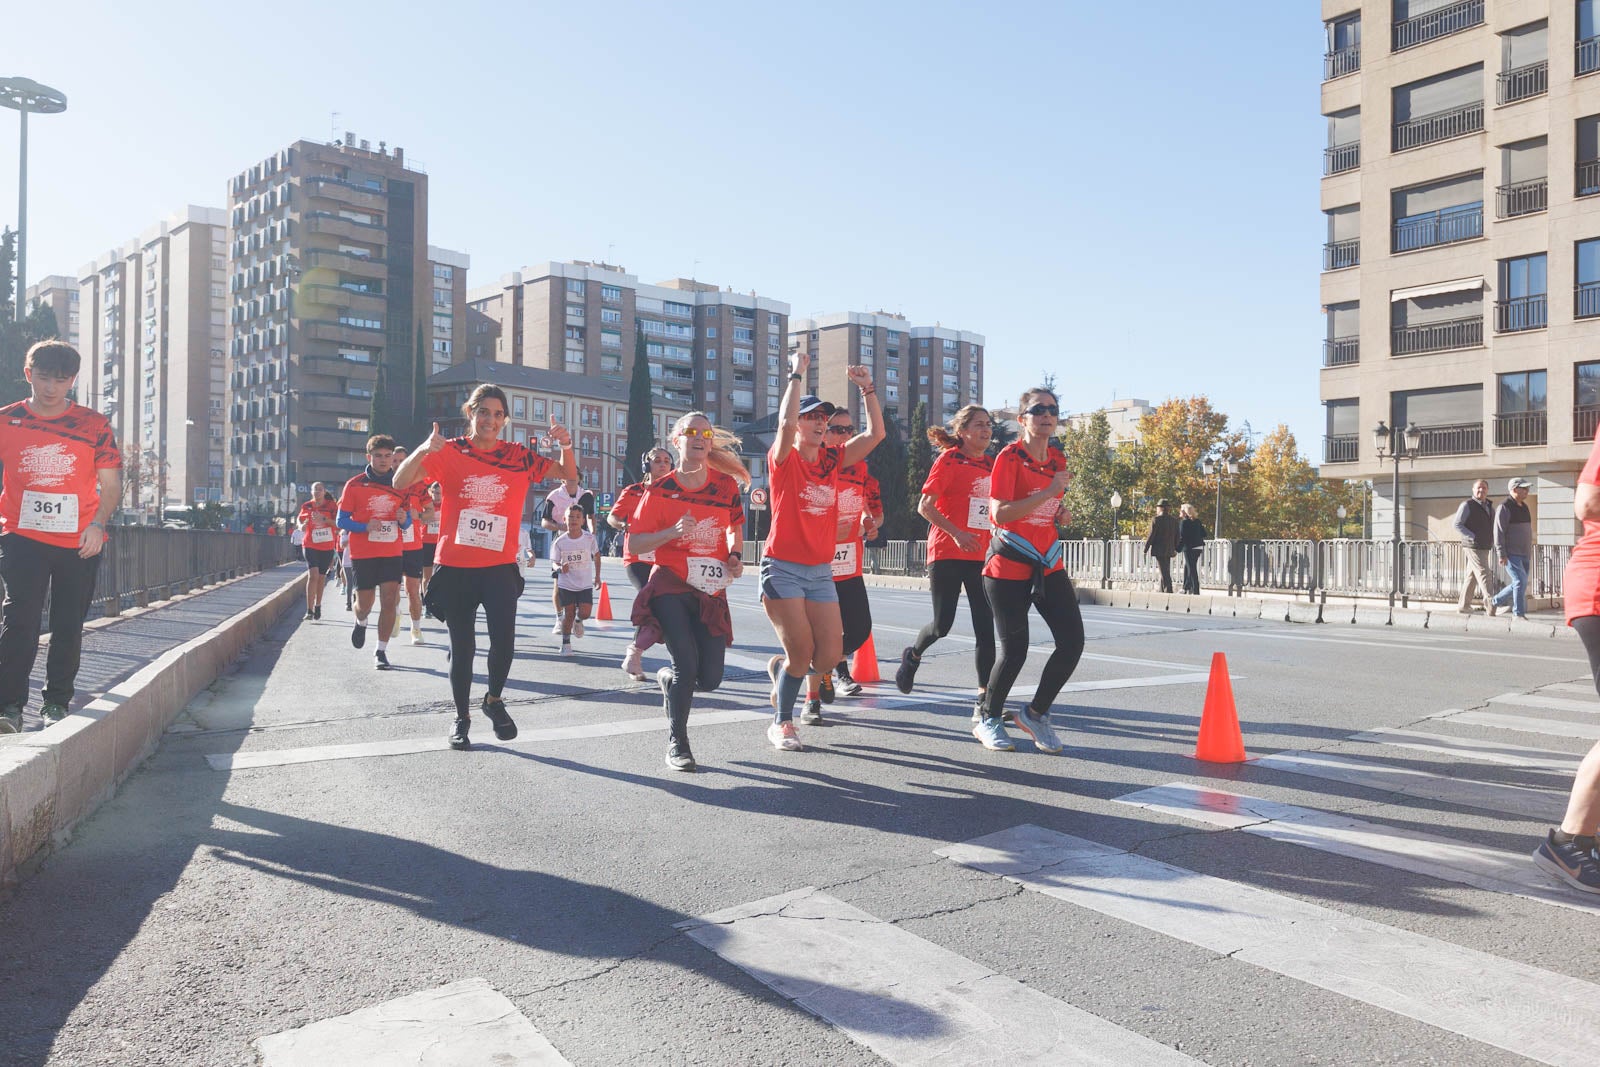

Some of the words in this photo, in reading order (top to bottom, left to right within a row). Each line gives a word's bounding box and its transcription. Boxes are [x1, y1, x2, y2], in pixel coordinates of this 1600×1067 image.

[603, 493, 611, 503] P
[34, 500, 62, 514] 361
[470, 518, 493, 533] 901
[567, 554, 582, 562] 639
[700, 564, 723, 578] 733
